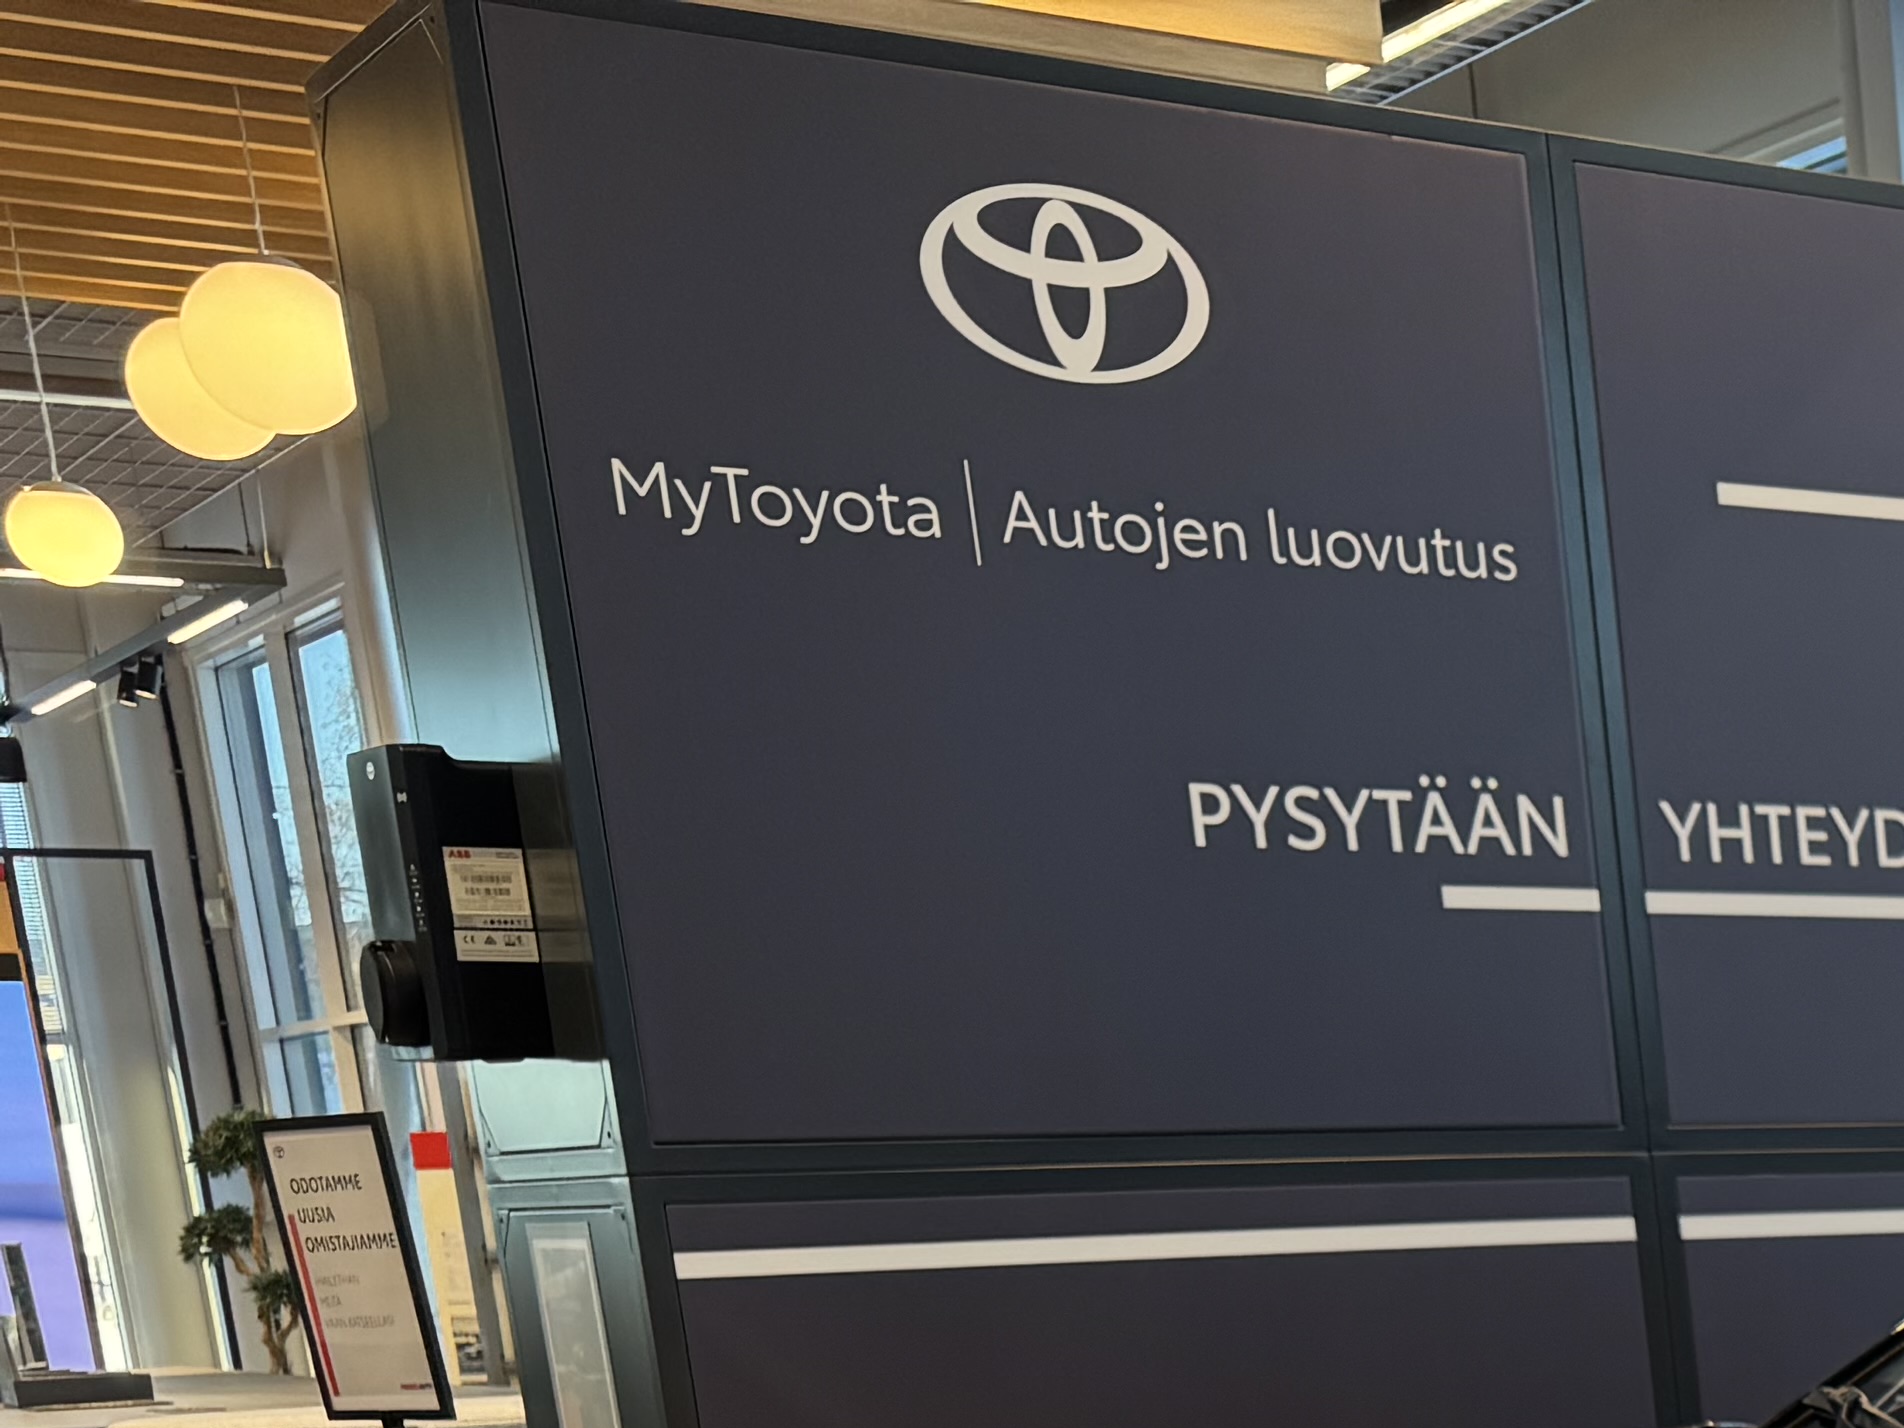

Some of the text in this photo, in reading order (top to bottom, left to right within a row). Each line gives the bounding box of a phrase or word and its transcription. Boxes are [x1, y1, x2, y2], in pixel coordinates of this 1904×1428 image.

[610, 457, 1518, 581] MyToyota Autojen luovutus
[1188, 774, 1569, 858] PYSYTÄÄN
[289, 1173, 363, 1195] ODOTAMME
[297, 1206, 336, 1224] UUSIA
[304, 1232, 398, 1254] OMISTAJIAMME
